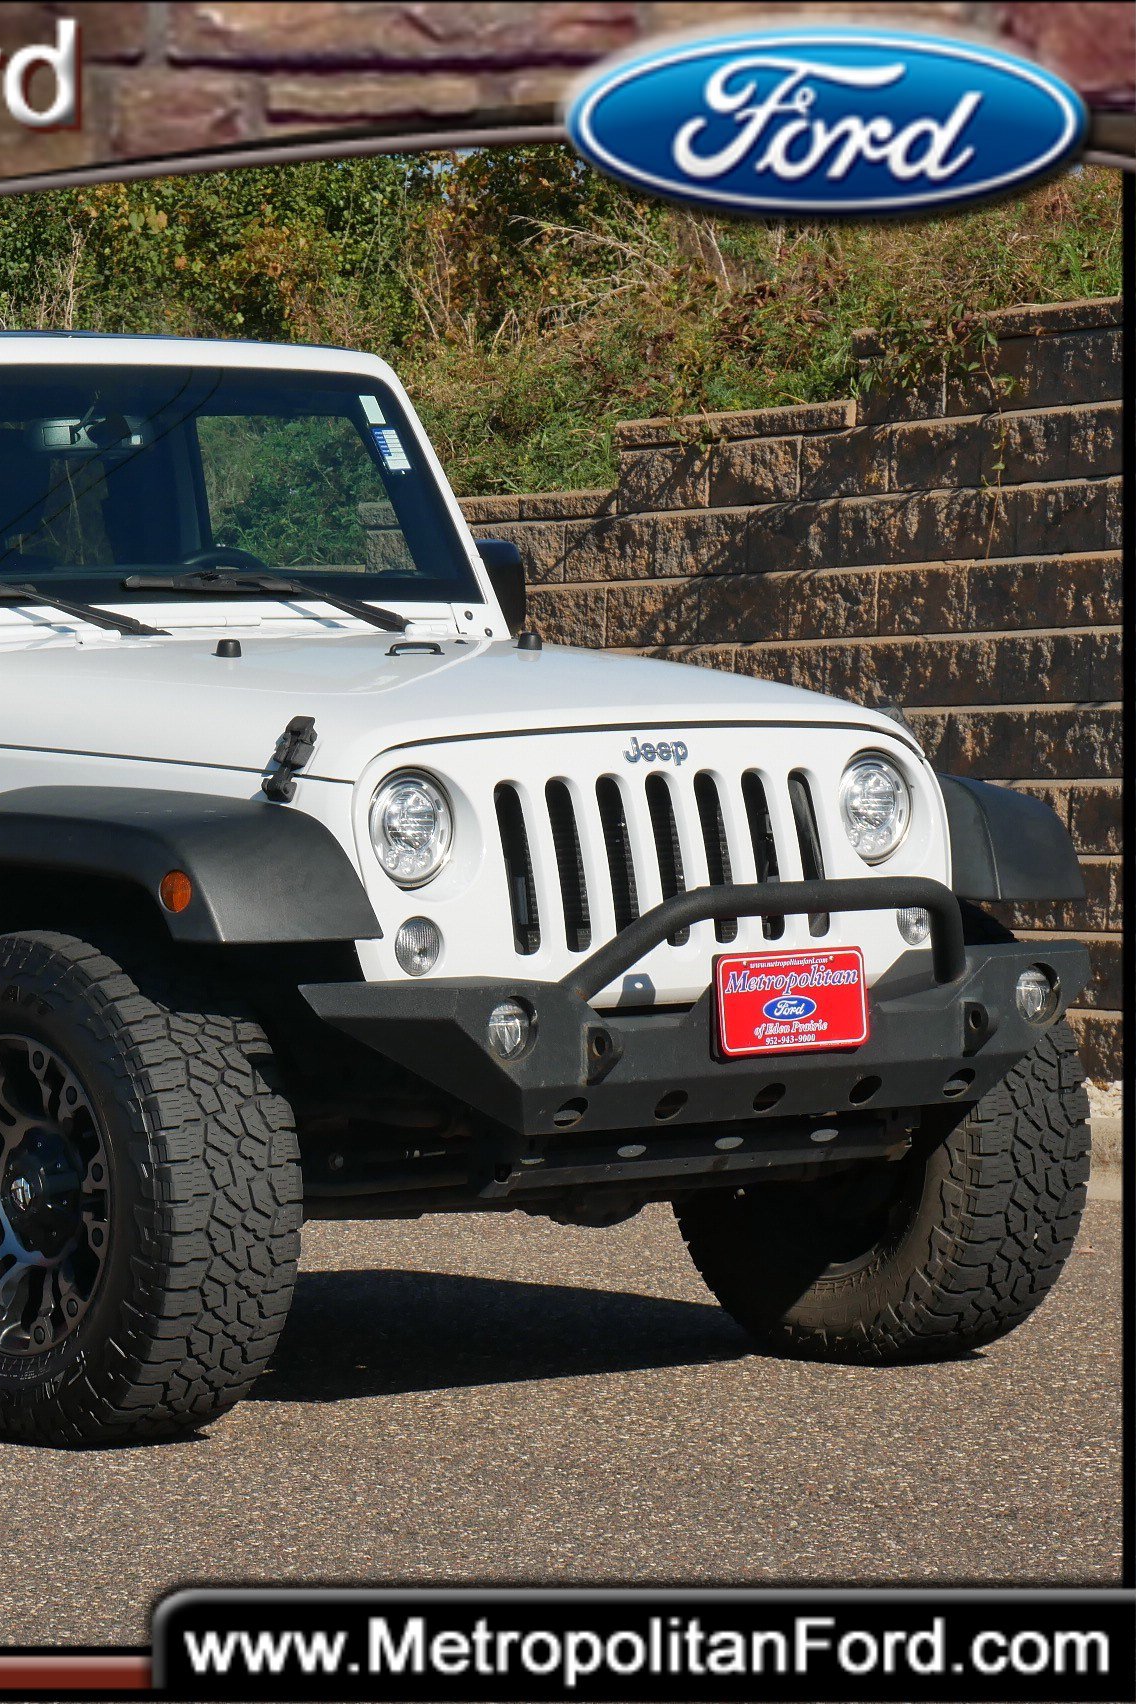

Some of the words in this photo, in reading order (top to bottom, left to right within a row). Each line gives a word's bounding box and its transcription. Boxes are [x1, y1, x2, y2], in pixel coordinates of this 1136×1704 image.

[623, 736, 689, 767] Jeep
[724, 964, 858, 996] Metropolitan
[773, 999, 806, 1016] Ford
[753, 1023, 765, 1040] of
[765, 1022, 791, 1036] Eden
[791, 1018, 829, 1034] Prairie
[765, 1033, 817, 1046] 952-943-9000
